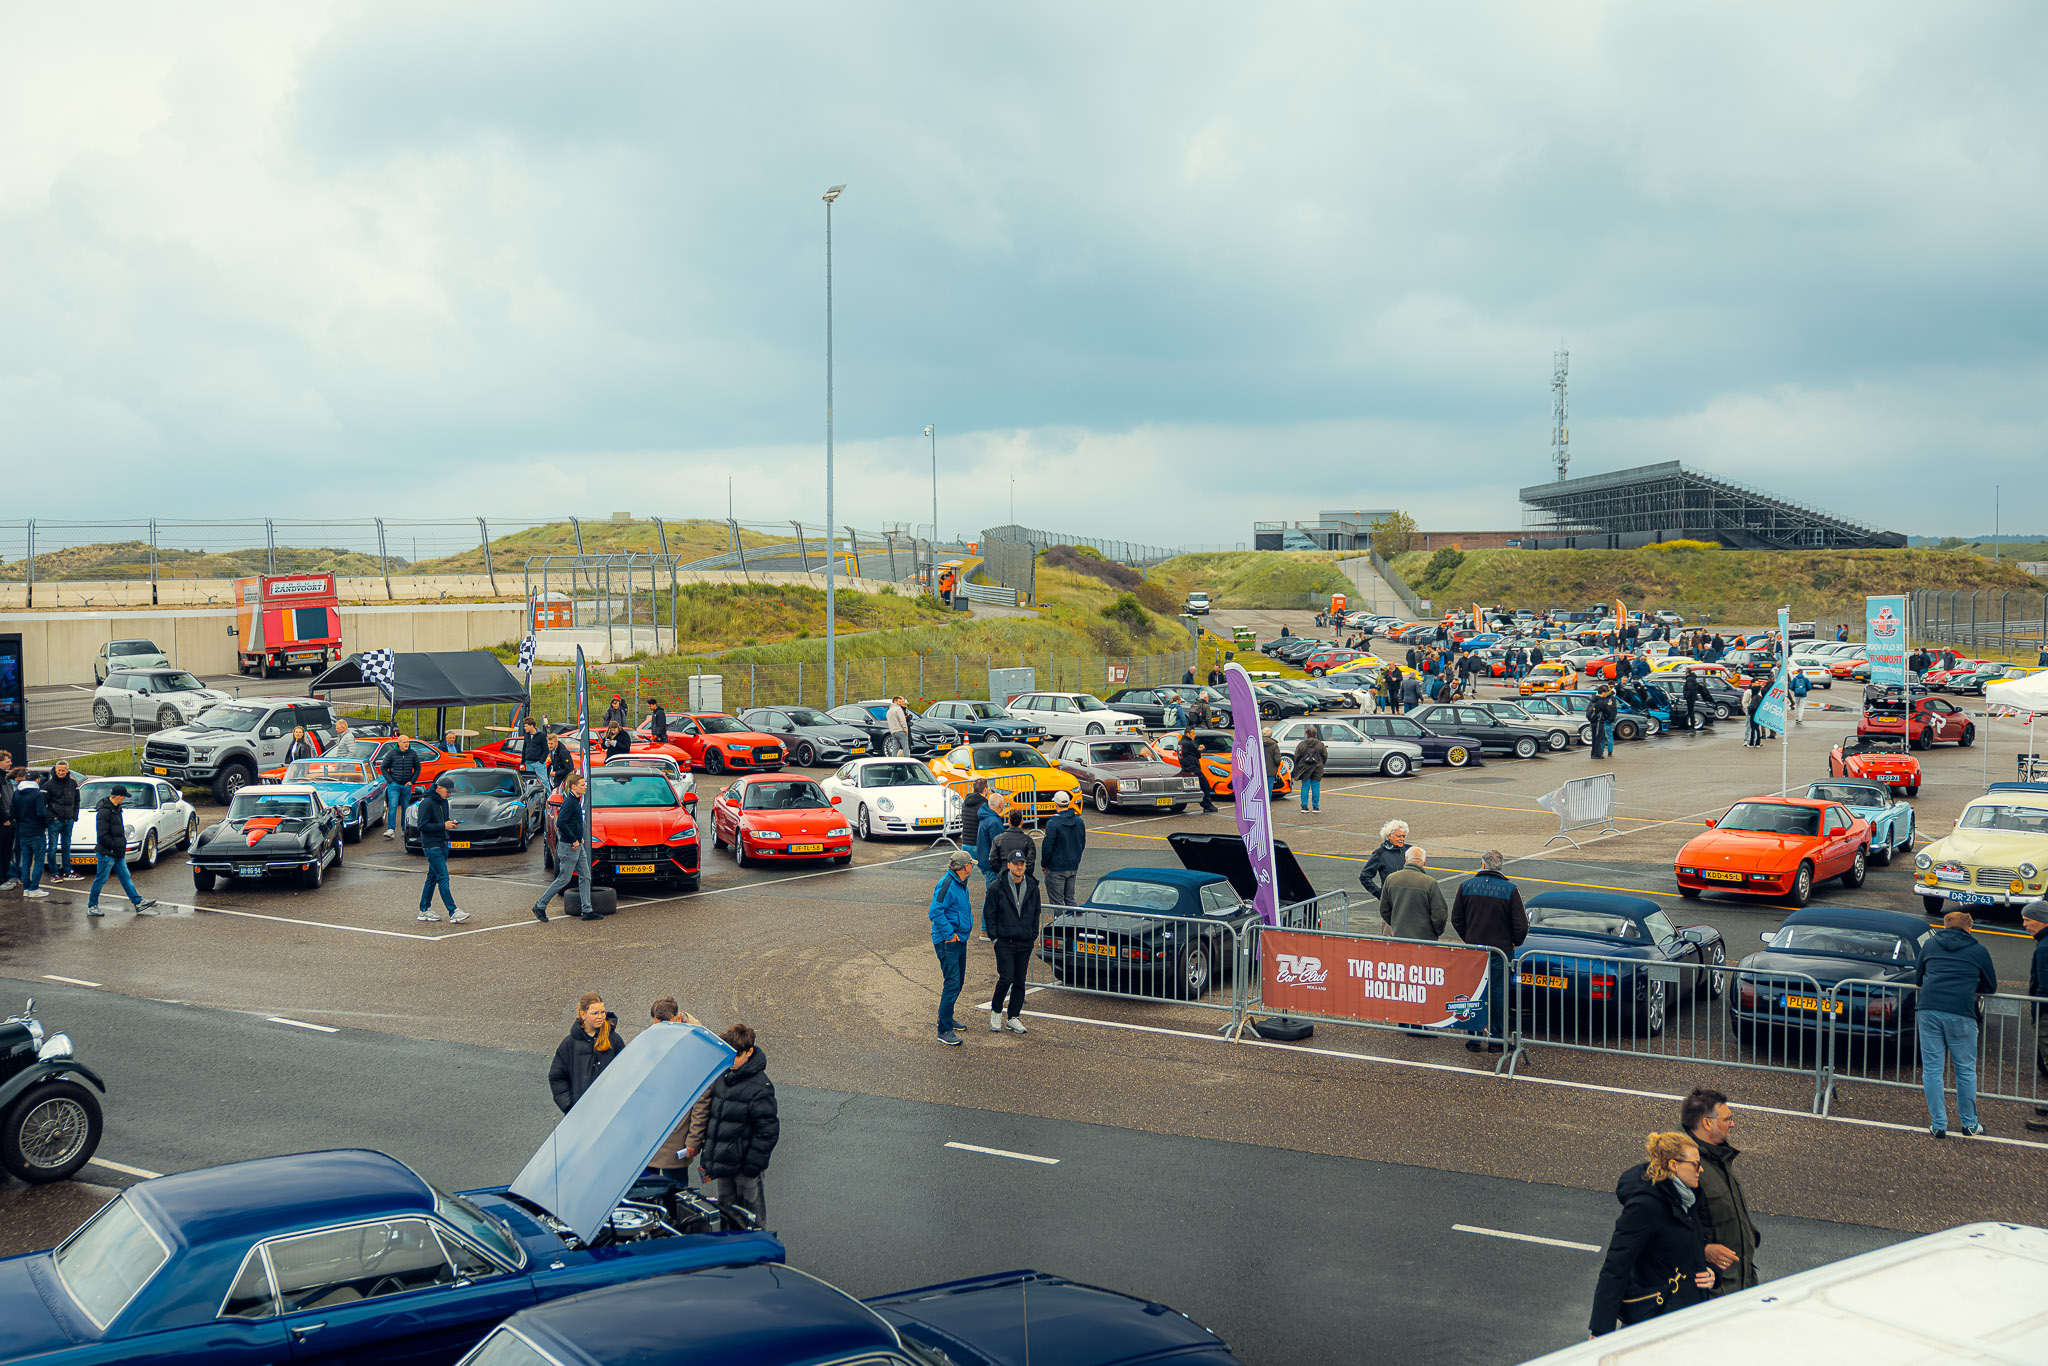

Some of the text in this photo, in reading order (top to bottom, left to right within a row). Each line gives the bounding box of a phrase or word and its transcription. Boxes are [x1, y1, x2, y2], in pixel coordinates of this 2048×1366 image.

[274, 584, 323, 593] ZANDVOORT
[1951, 892, 1991, 904] DR-20-63
[1276, 953, 1322, 975] TVR
[1276, 968, 1329, 983] Car Club
[1347, 958, 1445, 986] TVR CAR CLUB
[1521, 974, 1565, 987] 03GRH-7
[1364, 979, 1427, 1004] HOLLAND
